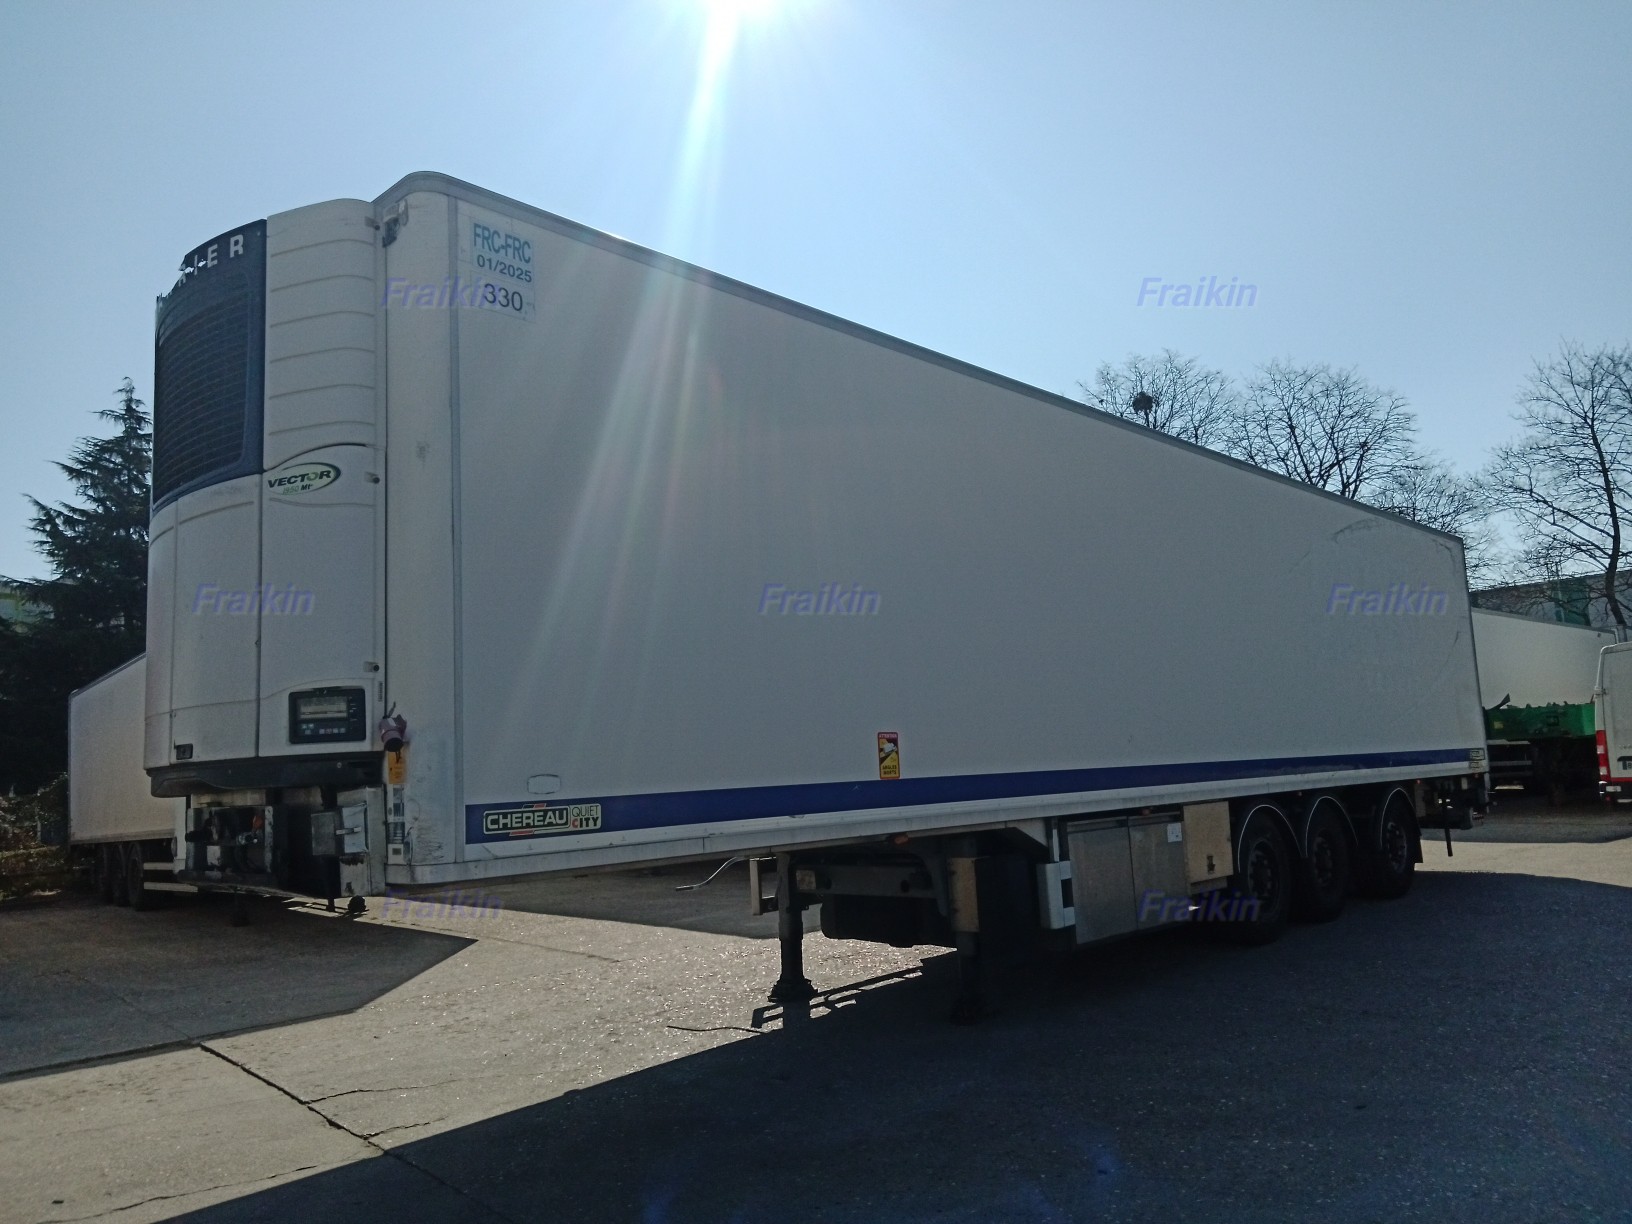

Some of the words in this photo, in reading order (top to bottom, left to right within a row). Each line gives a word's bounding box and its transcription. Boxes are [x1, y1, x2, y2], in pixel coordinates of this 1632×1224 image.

[473, 222, 531, 264] FRC-FRC
[477, 254, 532, 283] 01/2025
[484, 283, 523, 312] 330
[267, 470, 332, 488] VECTOR
[486, 809, 567, 829] CHEREAU
[571, 805, 599, 818] QUIET
[571, 816, 599, 829] CITY
